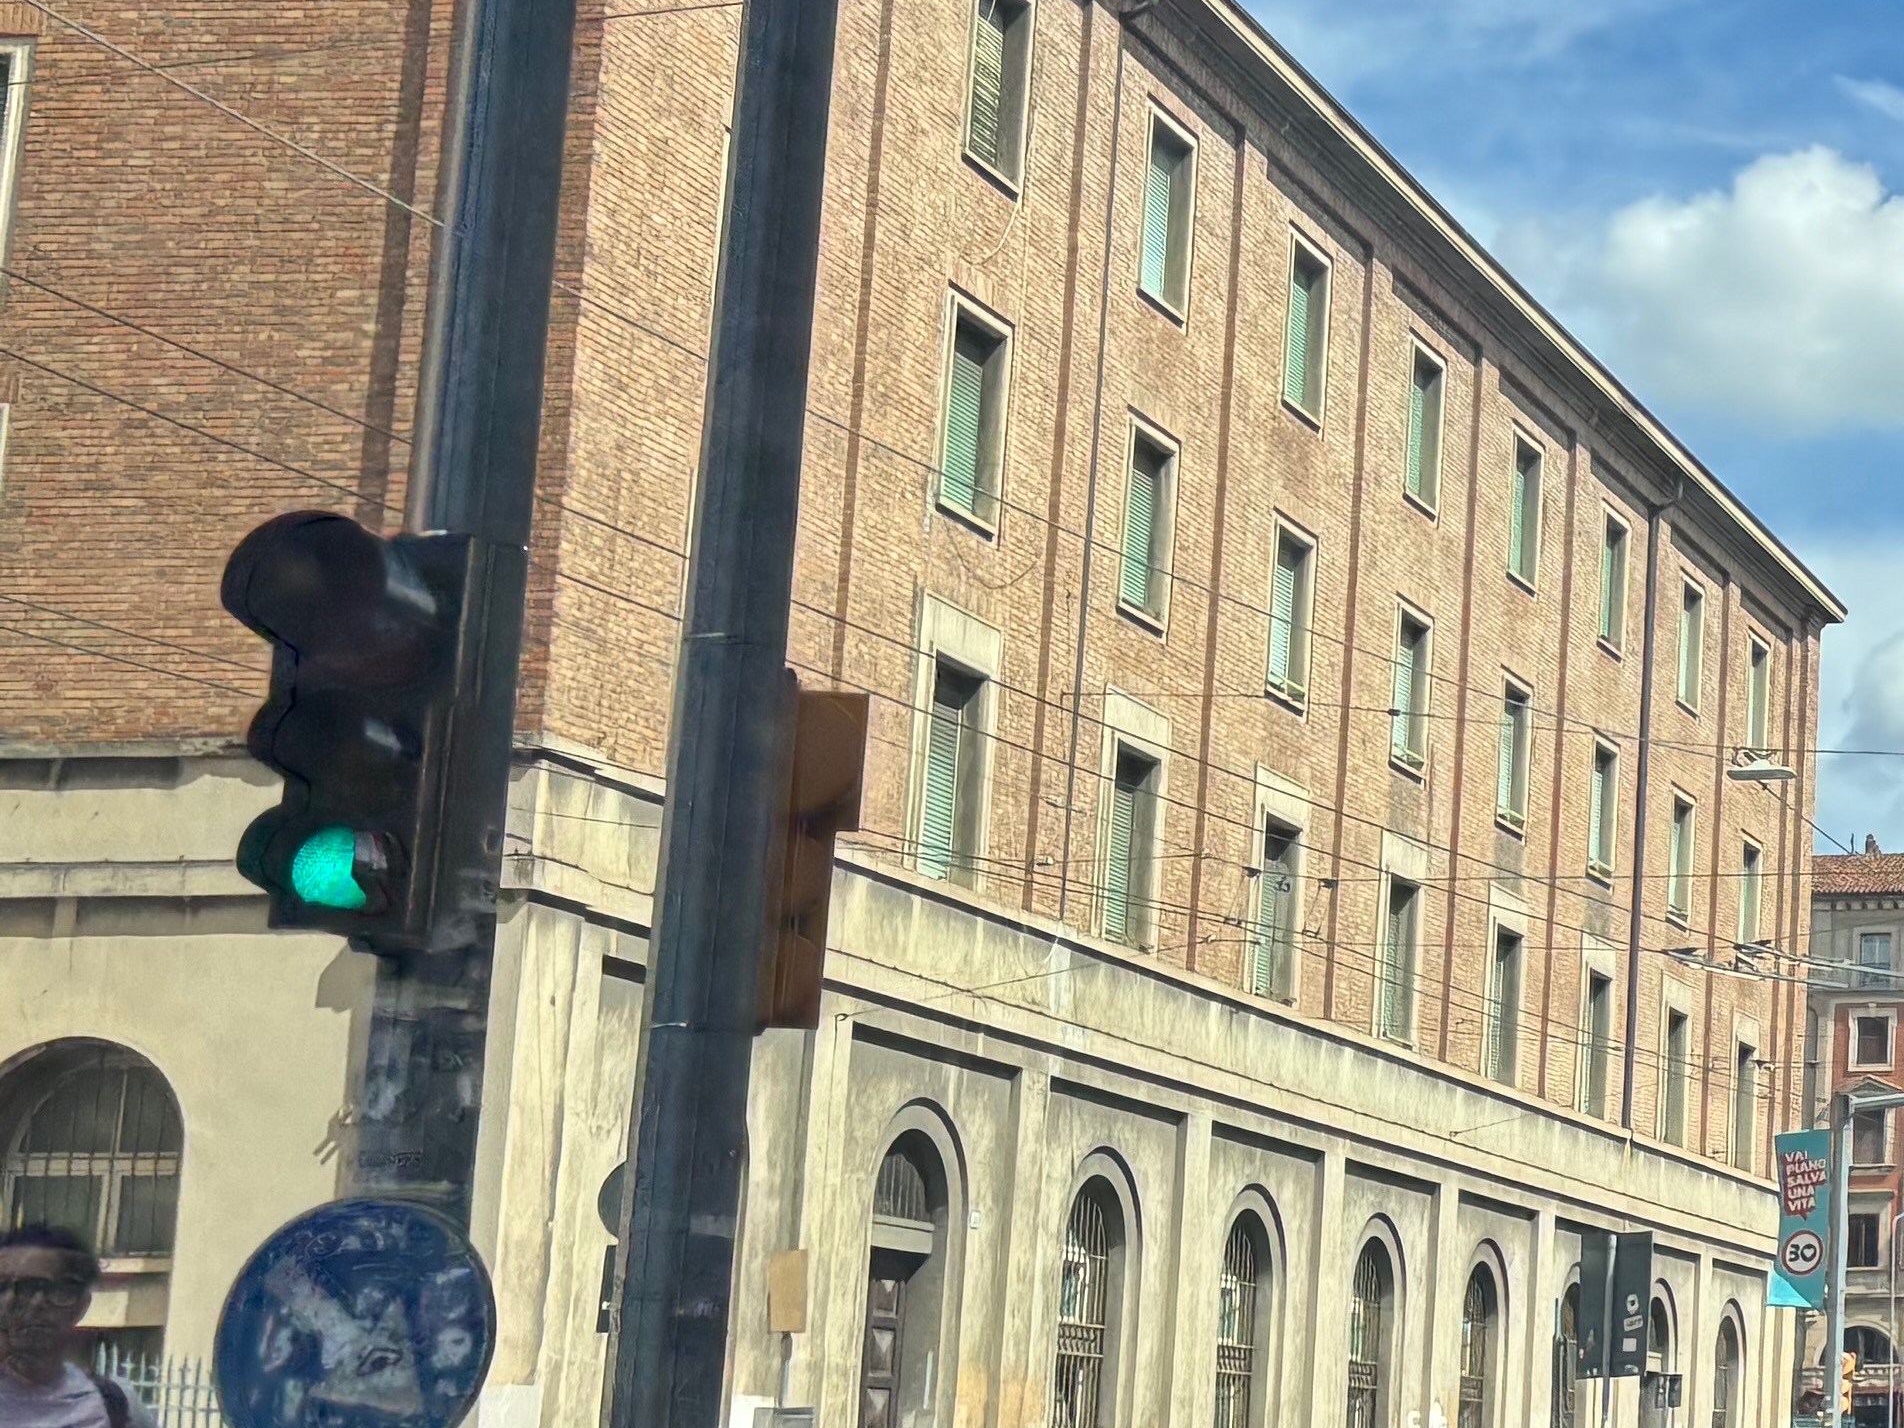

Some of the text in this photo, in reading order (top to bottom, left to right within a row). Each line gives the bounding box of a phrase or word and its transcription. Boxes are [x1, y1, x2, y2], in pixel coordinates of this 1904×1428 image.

[1785, 1150, 1808, 1163] VAI
[1786, 1159, 1827, 1175] PIANO
[1786, 1170, 1827, 1187] SALVA
[1787, 1185, 1816, 1200] UNA
[1787, 1196, 1816, 1212] VITA
[1788, 1243, 1817, 1263] 30
